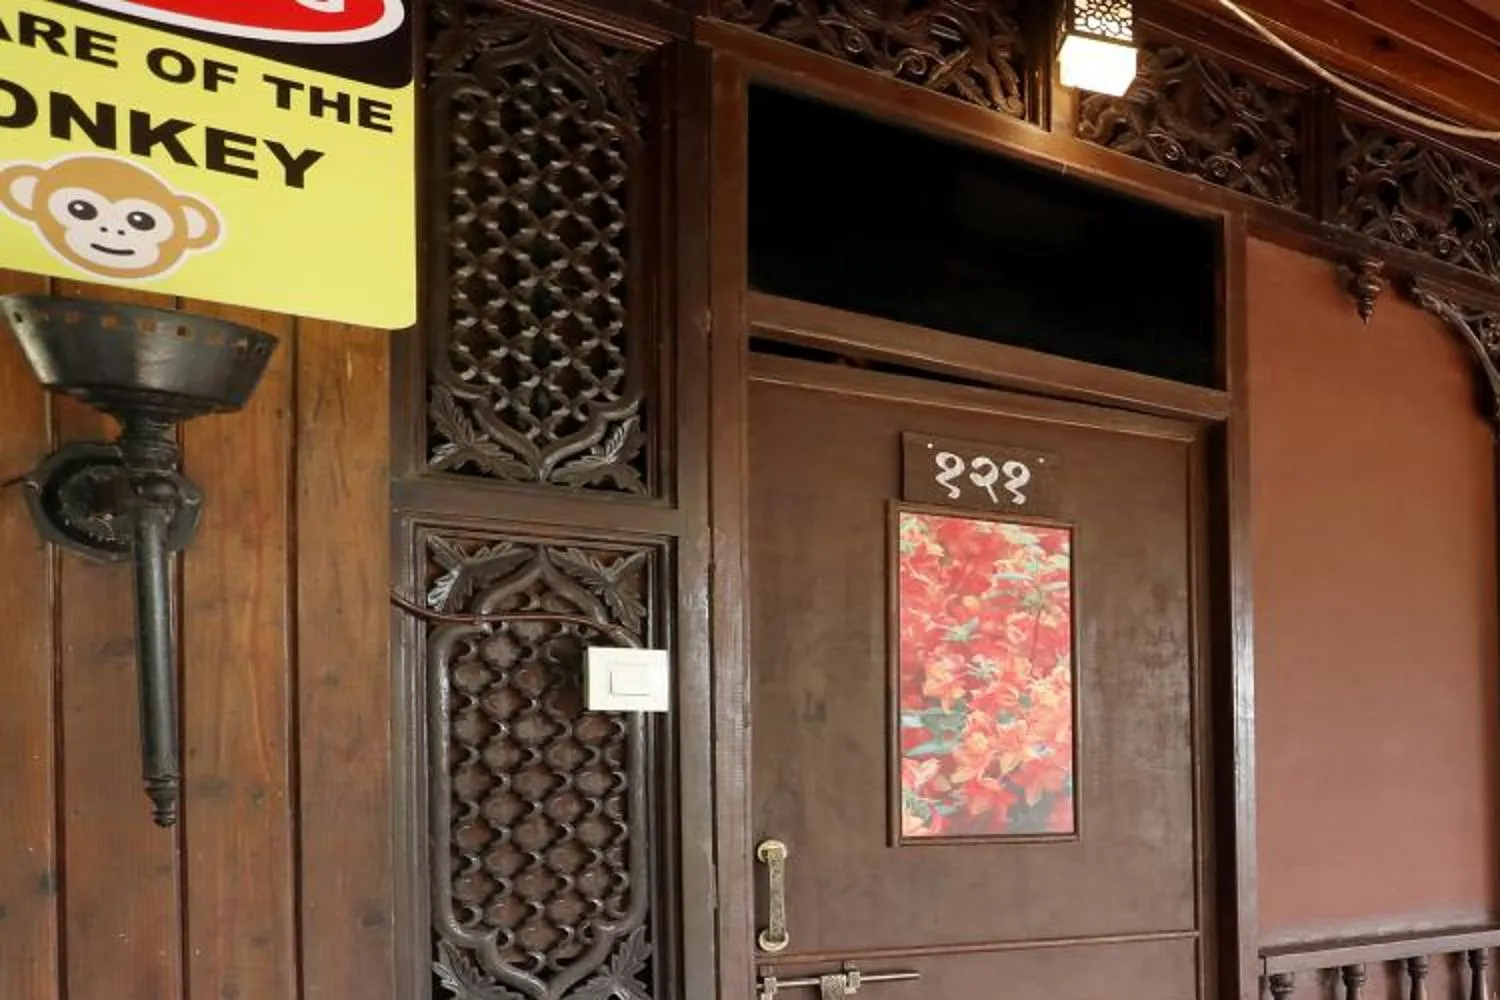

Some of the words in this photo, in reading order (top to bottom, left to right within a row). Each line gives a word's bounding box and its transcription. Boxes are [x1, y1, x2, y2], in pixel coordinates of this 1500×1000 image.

[0, 11, 118, 68] RE
[146, 47, 239, 92] OF
[263, 74, 393, 133] THE
